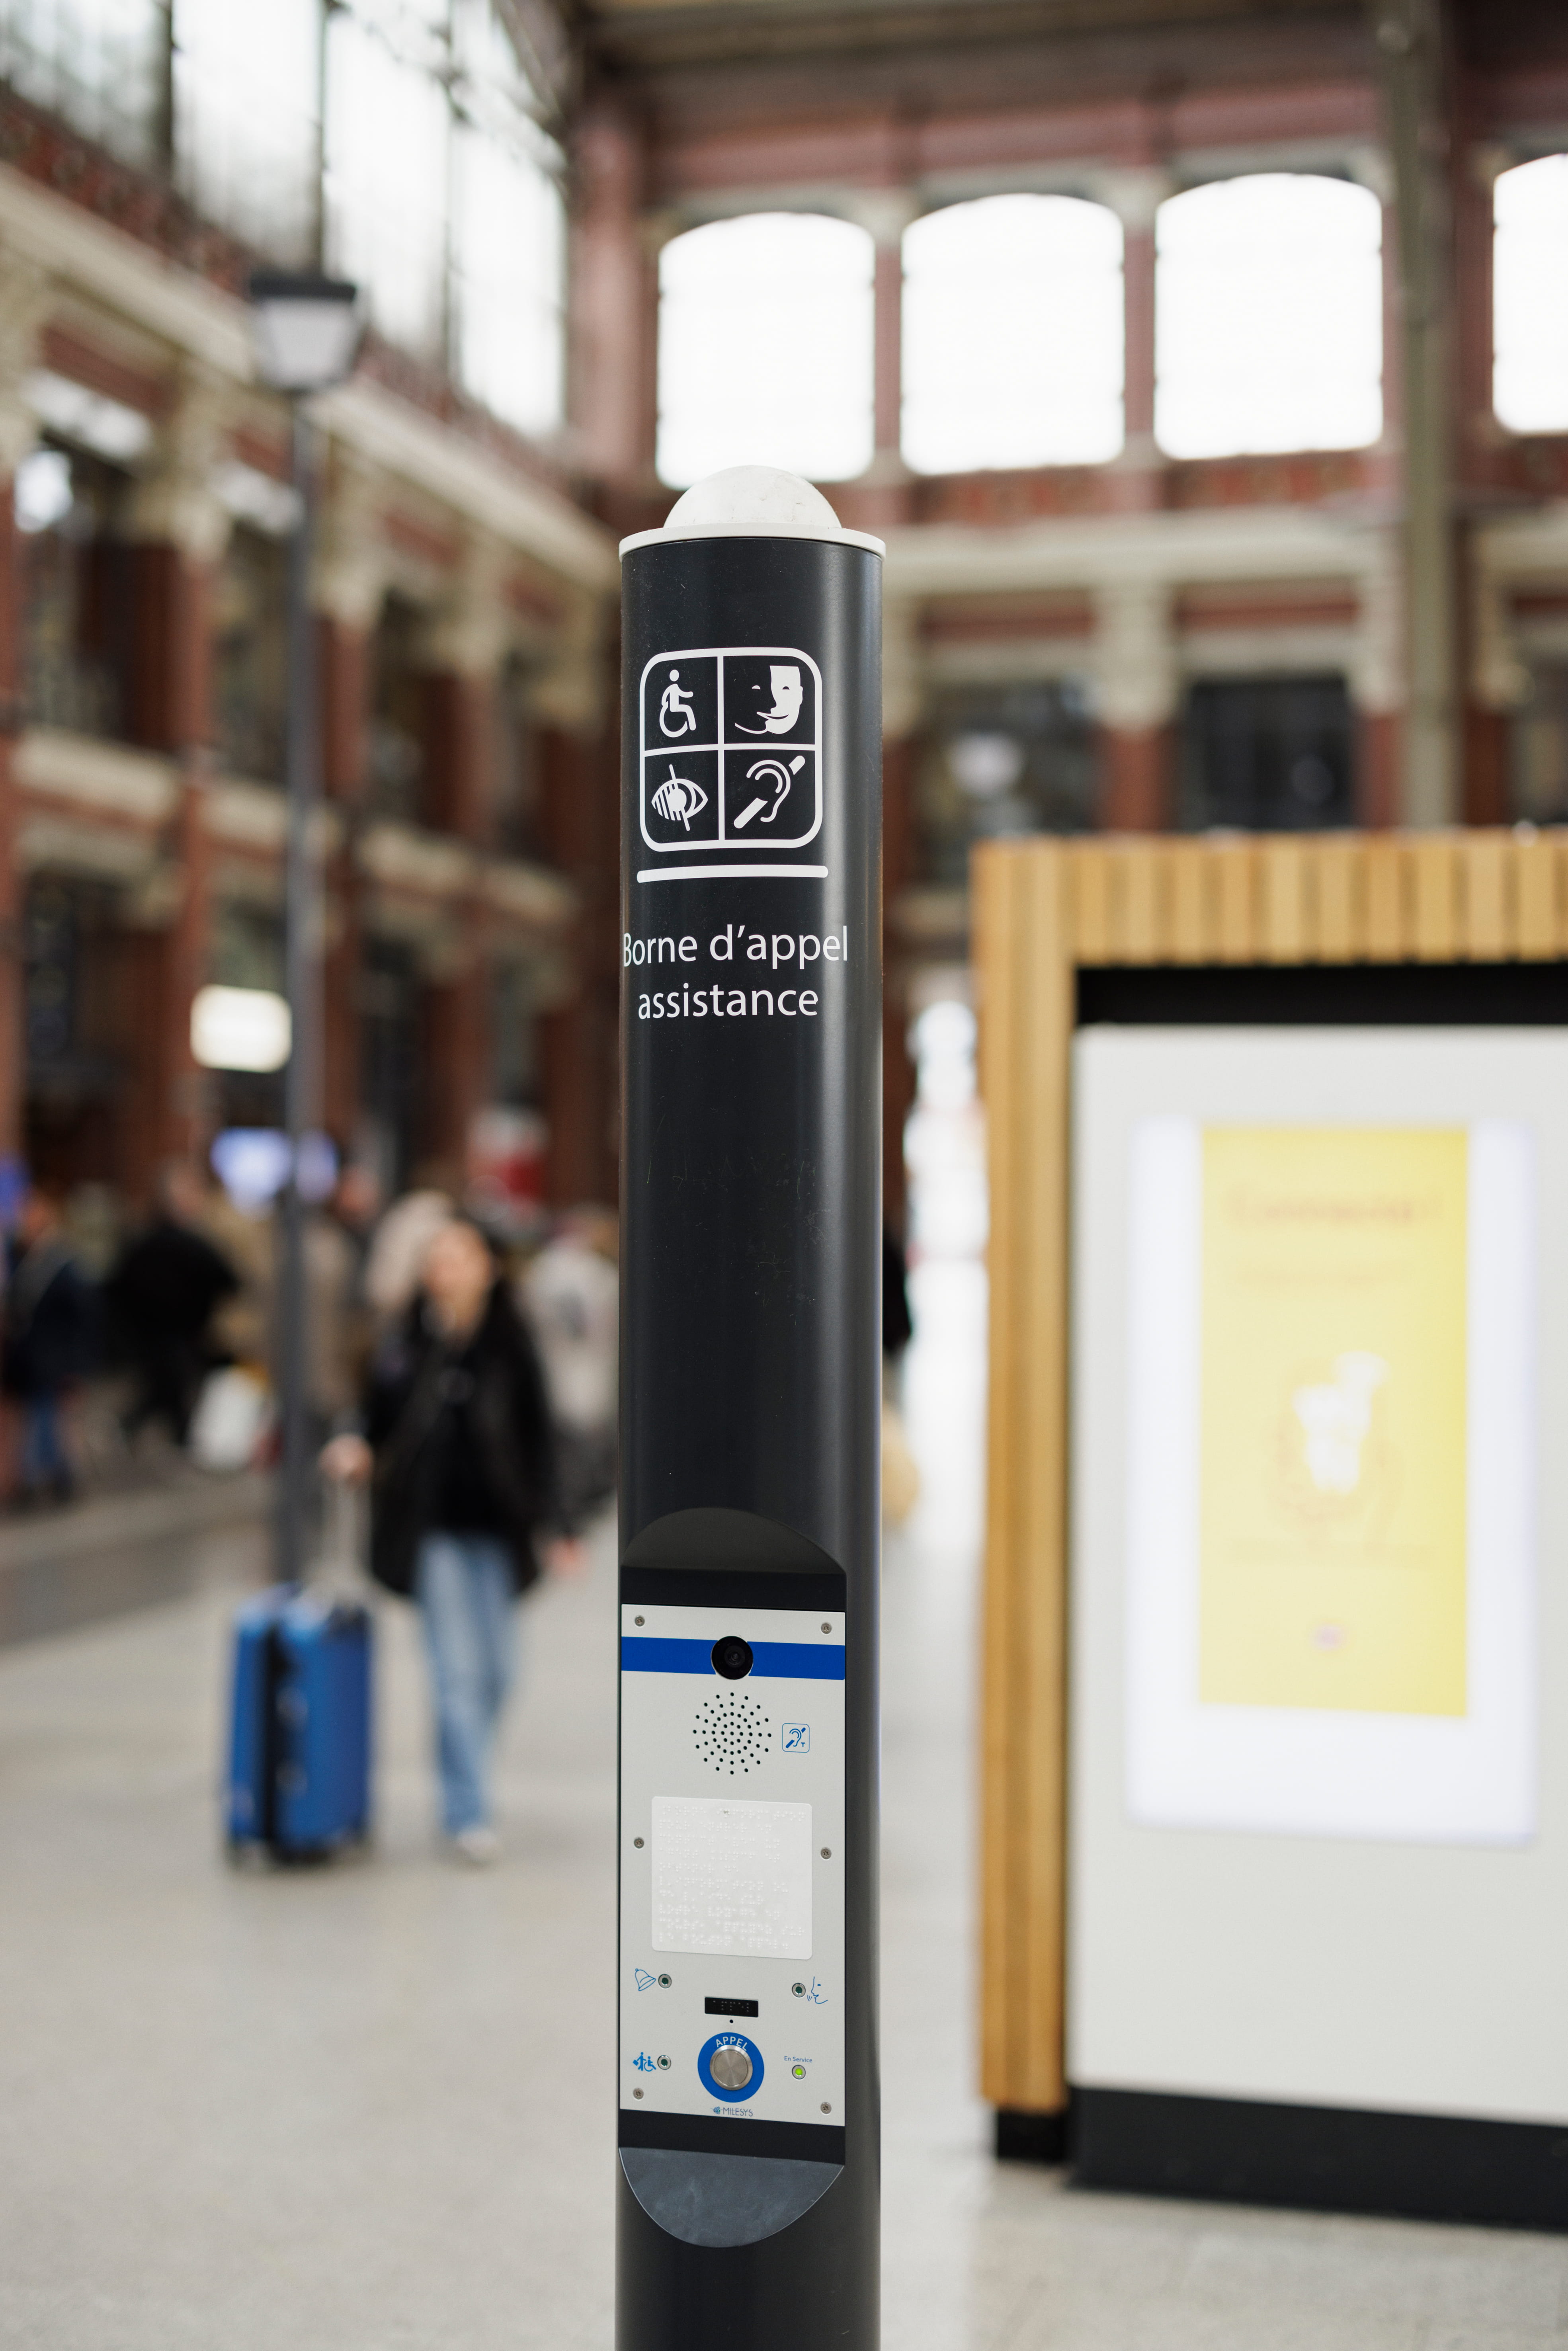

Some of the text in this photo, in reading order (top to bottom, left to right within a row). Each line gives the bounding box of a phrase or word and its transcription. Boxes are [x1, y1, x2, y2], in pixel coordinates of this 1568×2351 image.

[623, 924, 847, 969] Borne d’appel
[638, 983, 818, 1019] assistance
[716, 2036, 747, 2051] APPEL
[723, 2107, 753, 2117] MILESYS
